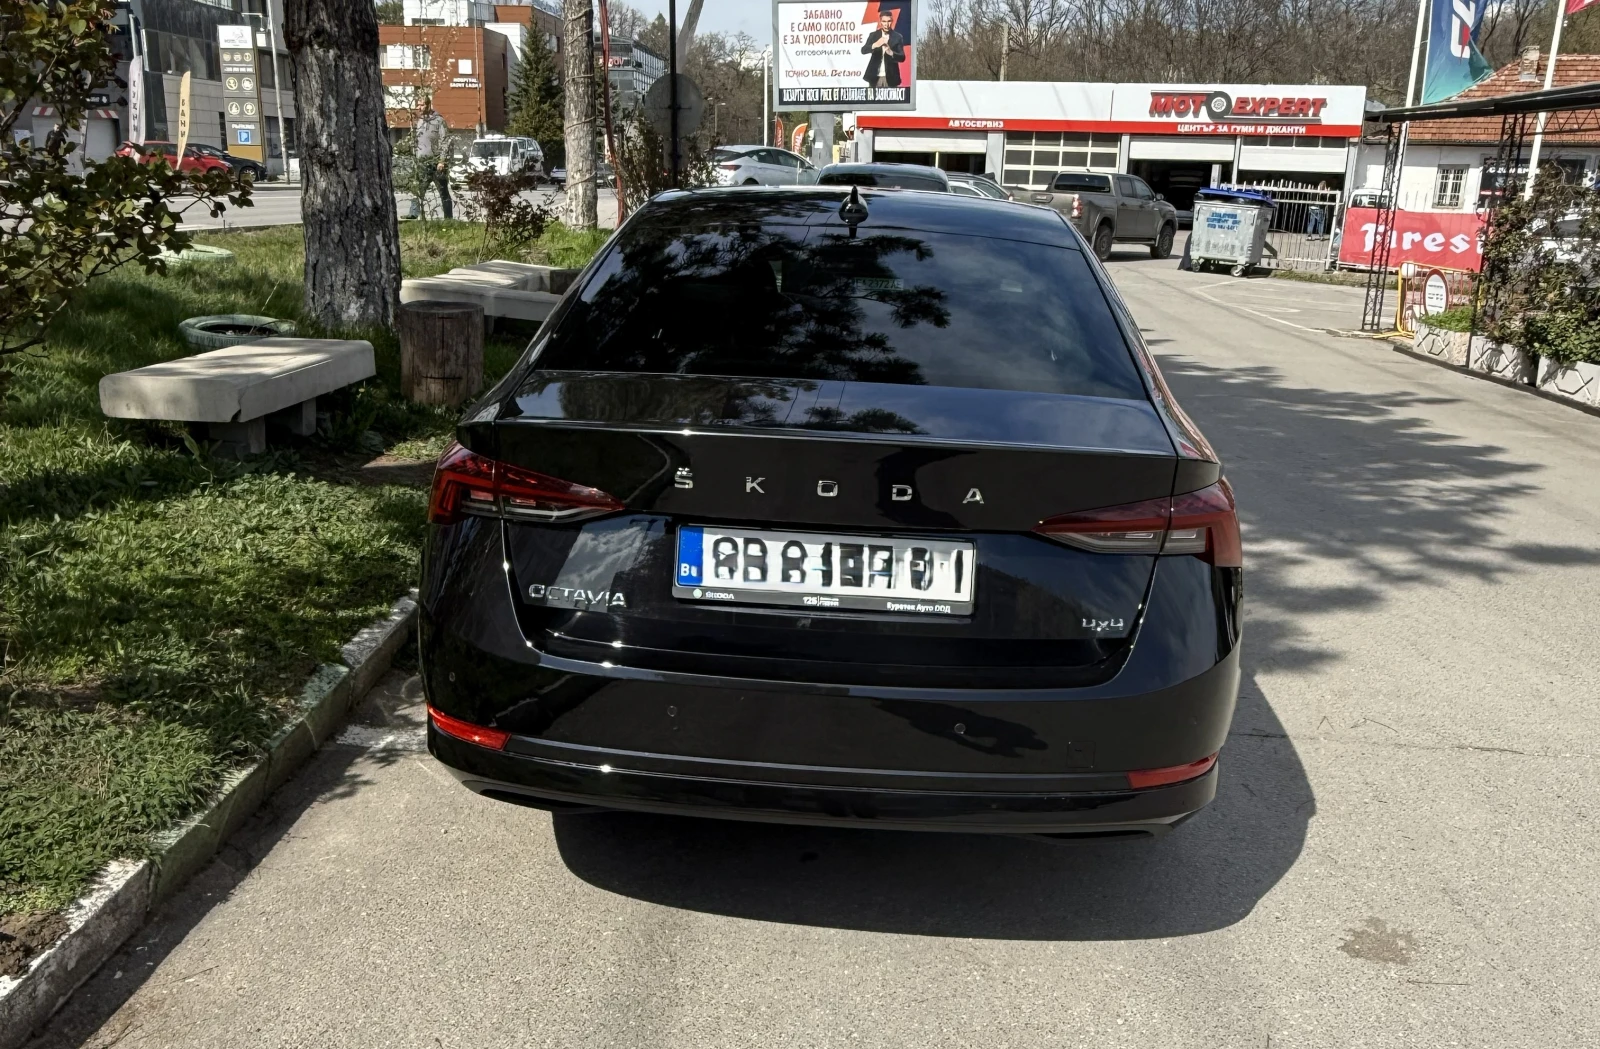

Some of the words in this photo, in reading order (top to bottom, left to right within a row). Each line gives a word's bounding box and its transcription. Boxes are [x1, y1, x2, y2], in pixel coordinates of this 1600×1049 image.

[803, 10, 843, 20] ЗАБАВНО
[790, 22, 795, 32] Е
[797, 22, 822, 32] САМО
[824, 21, 856, 32] КОГАТО
[783, 35, 788, 45] Е
[790, 34, 801, 45] ЗА
[803, 34, 863, 46] УДОВОЛСТВИЕ
[830, 69, 862, 77] Betano
[1231, 97, 1327, 118] EXPERT
[948, 119, 1004, 128] АВТОСЕРВИЗ
[1177, 124, 1214, 133] ЦЕНТЪР
[1216, 125, 1229, 133] ЗА
[1230, 125, 1255, 133] ГУМИ
[1256, 125, 1264, 133] И
[1265, 125, 1306, 134] ДЖАНТИ
[529, 584, 627, 608] OCTAVIA
